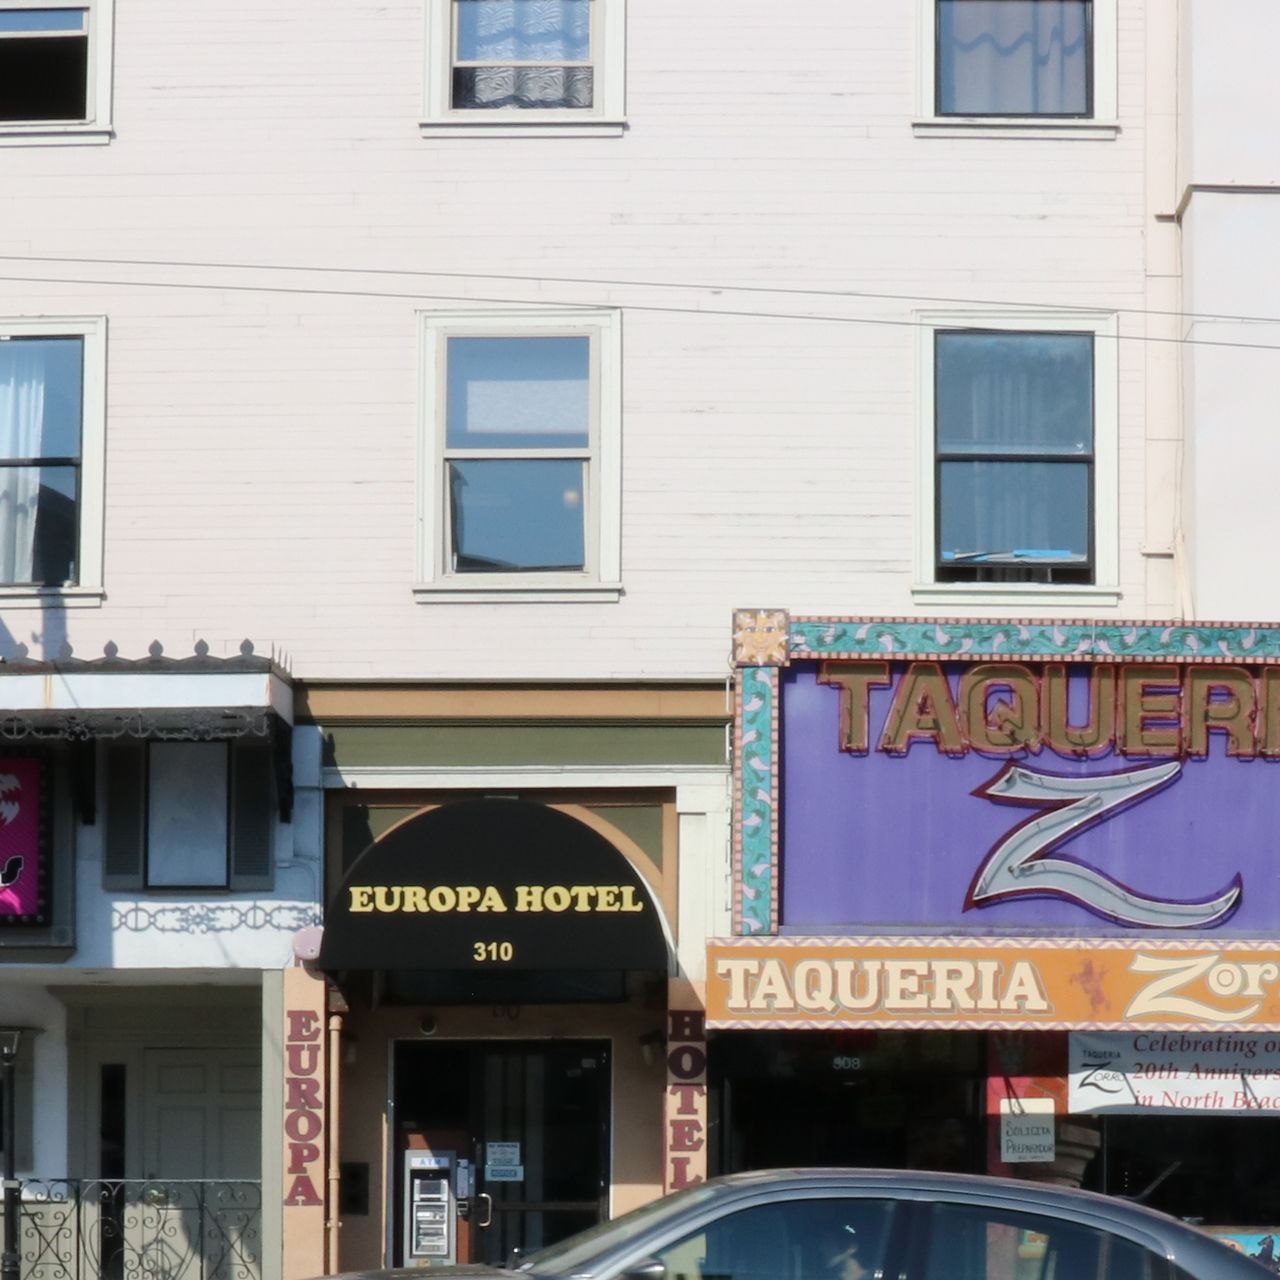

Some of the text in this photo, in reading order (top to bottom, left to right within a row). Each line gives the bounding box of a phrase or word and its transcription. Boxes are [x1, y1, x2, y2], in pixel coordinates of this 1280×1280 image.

[962, 758, 1245, 929] Z
[349, 885, 644, 913] EUROPA HOTEL
[473, 942, 513, 961] 310
[717, 956, 1054, 1017] TAQUERIA
[1082, 1050, 1122, 1059] TAQUERIA
[1133, 1035, 1259, 1059] Celebrating
[1132, 1062, 1179, 1080] 20th
[283, 1010, 323, 1207] EUROPA
[666, 1009, 707, 1189] HOTEL
[1135, 1090, 1153, 1108] in
[1156, 1090, 1226, 1108] North
